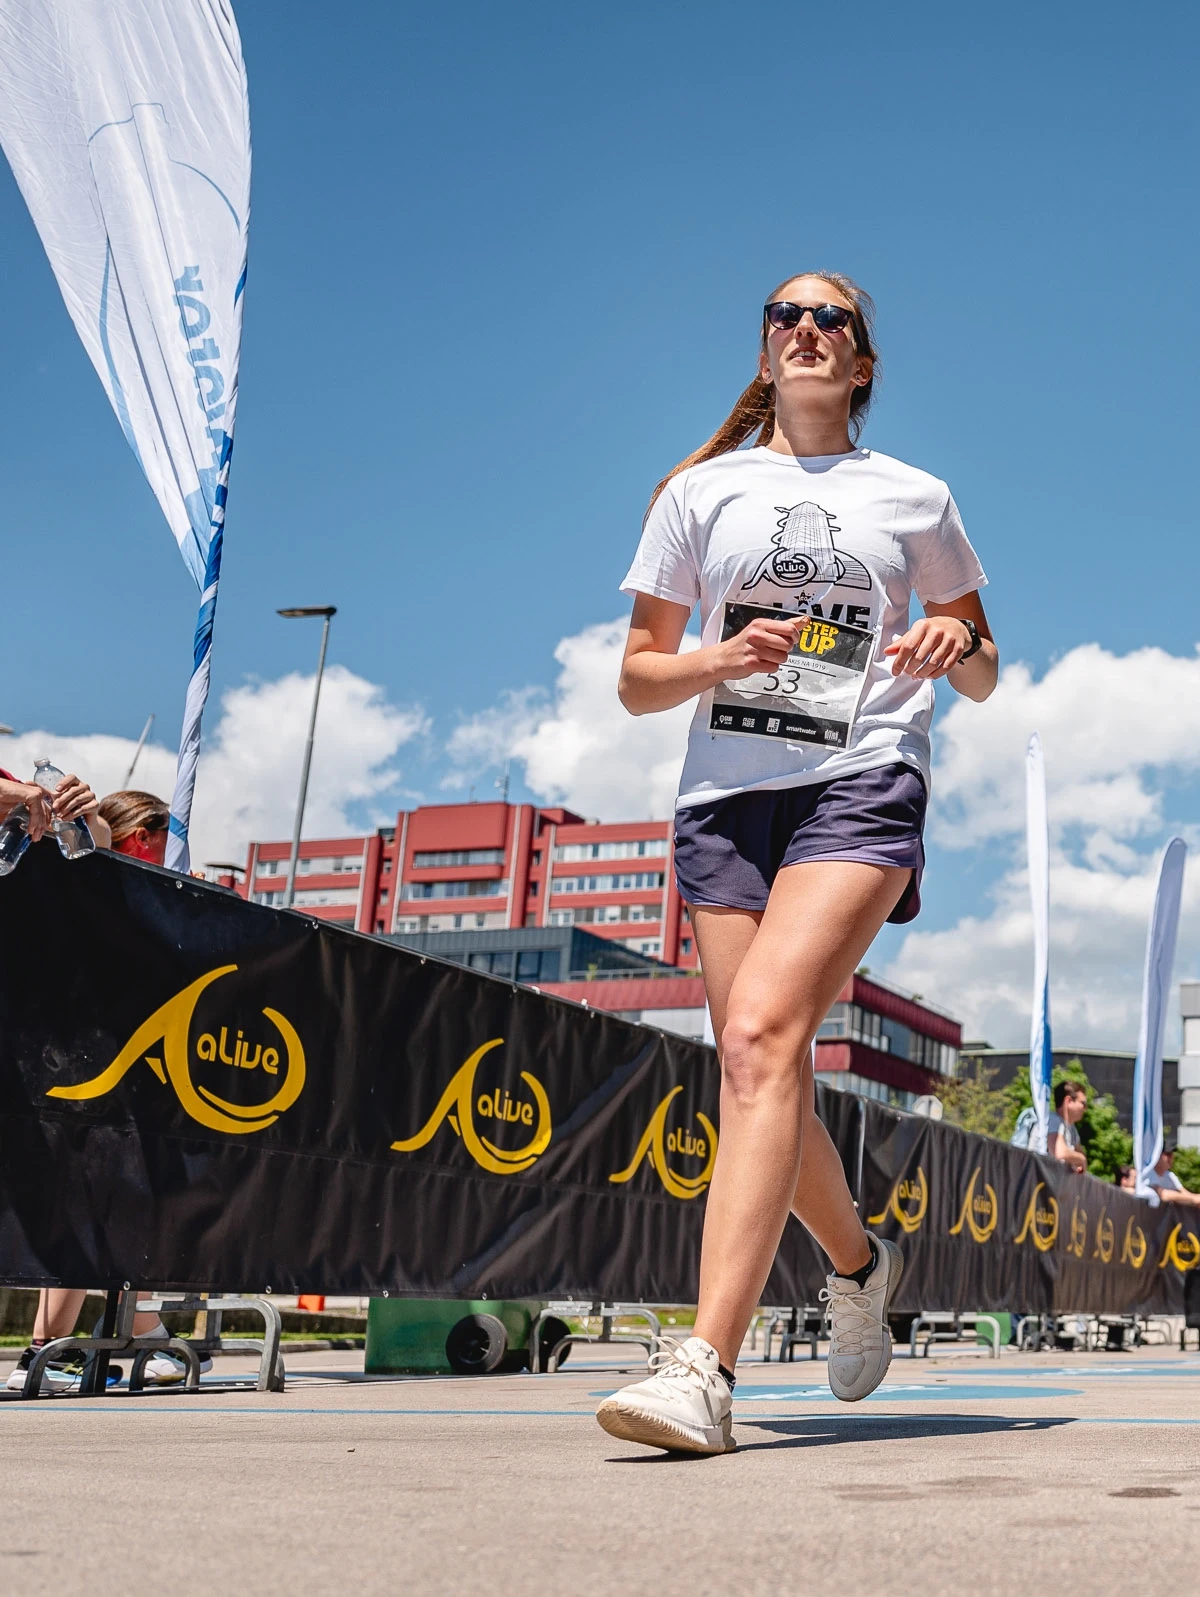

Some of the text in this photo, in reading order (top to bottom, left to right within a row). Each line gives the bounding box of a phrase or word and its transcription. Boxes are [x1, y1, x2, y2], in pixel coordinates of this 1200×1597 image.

[803, 621, 839, 636] STEP
[799, 632, 836, 655] UP
[763, 669, 801, 694] 53
